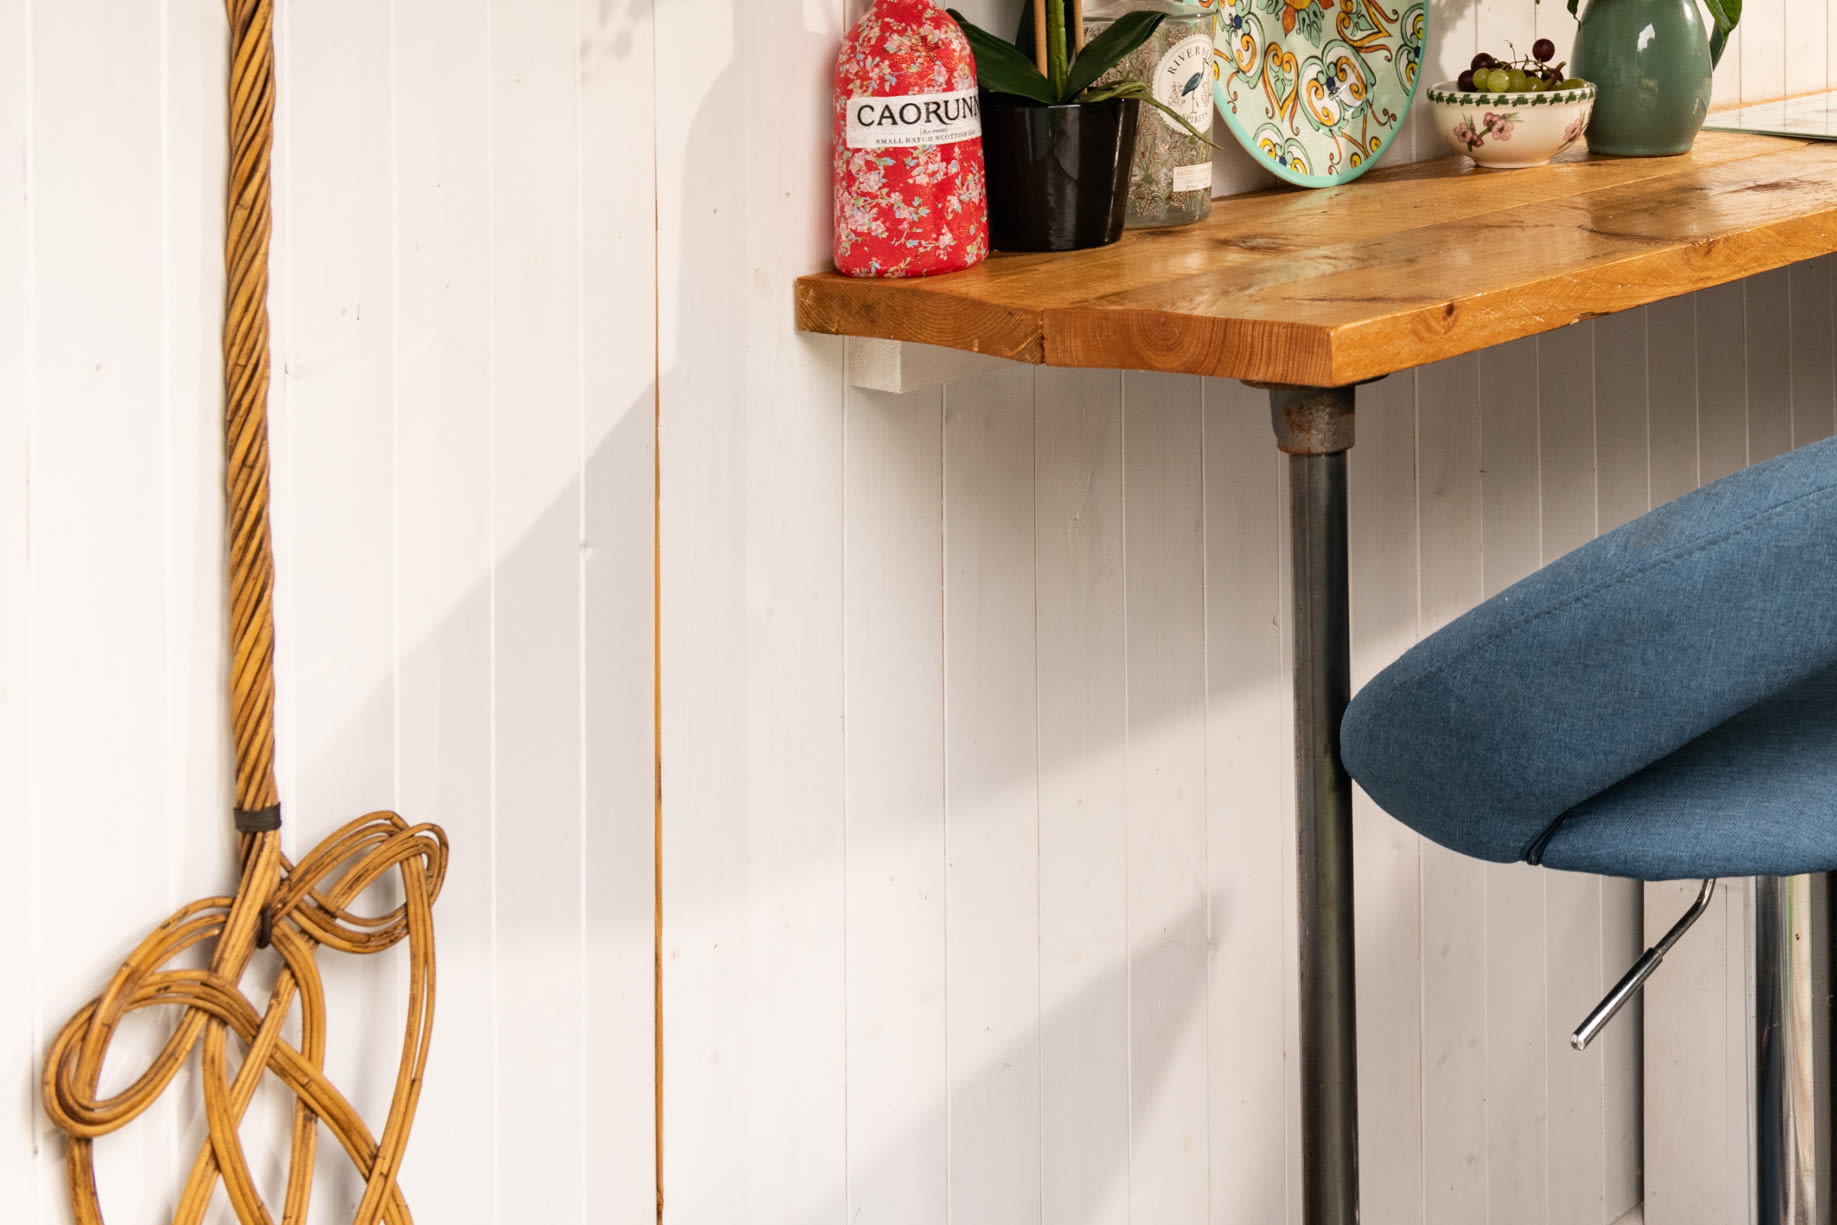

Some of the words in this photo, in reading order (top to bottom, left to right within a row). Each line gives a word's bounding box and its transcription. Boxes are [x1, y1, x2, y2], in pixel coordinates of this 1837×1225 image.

[1167, 46, 1213, 75] RIVERSID
[857, 95, 979, 126] CAORUNN
[875, 137, 904, 145] SMALL
[905, 135, 934, 144] BATCH
[935, 131, 968, 142] SCOTTISH
